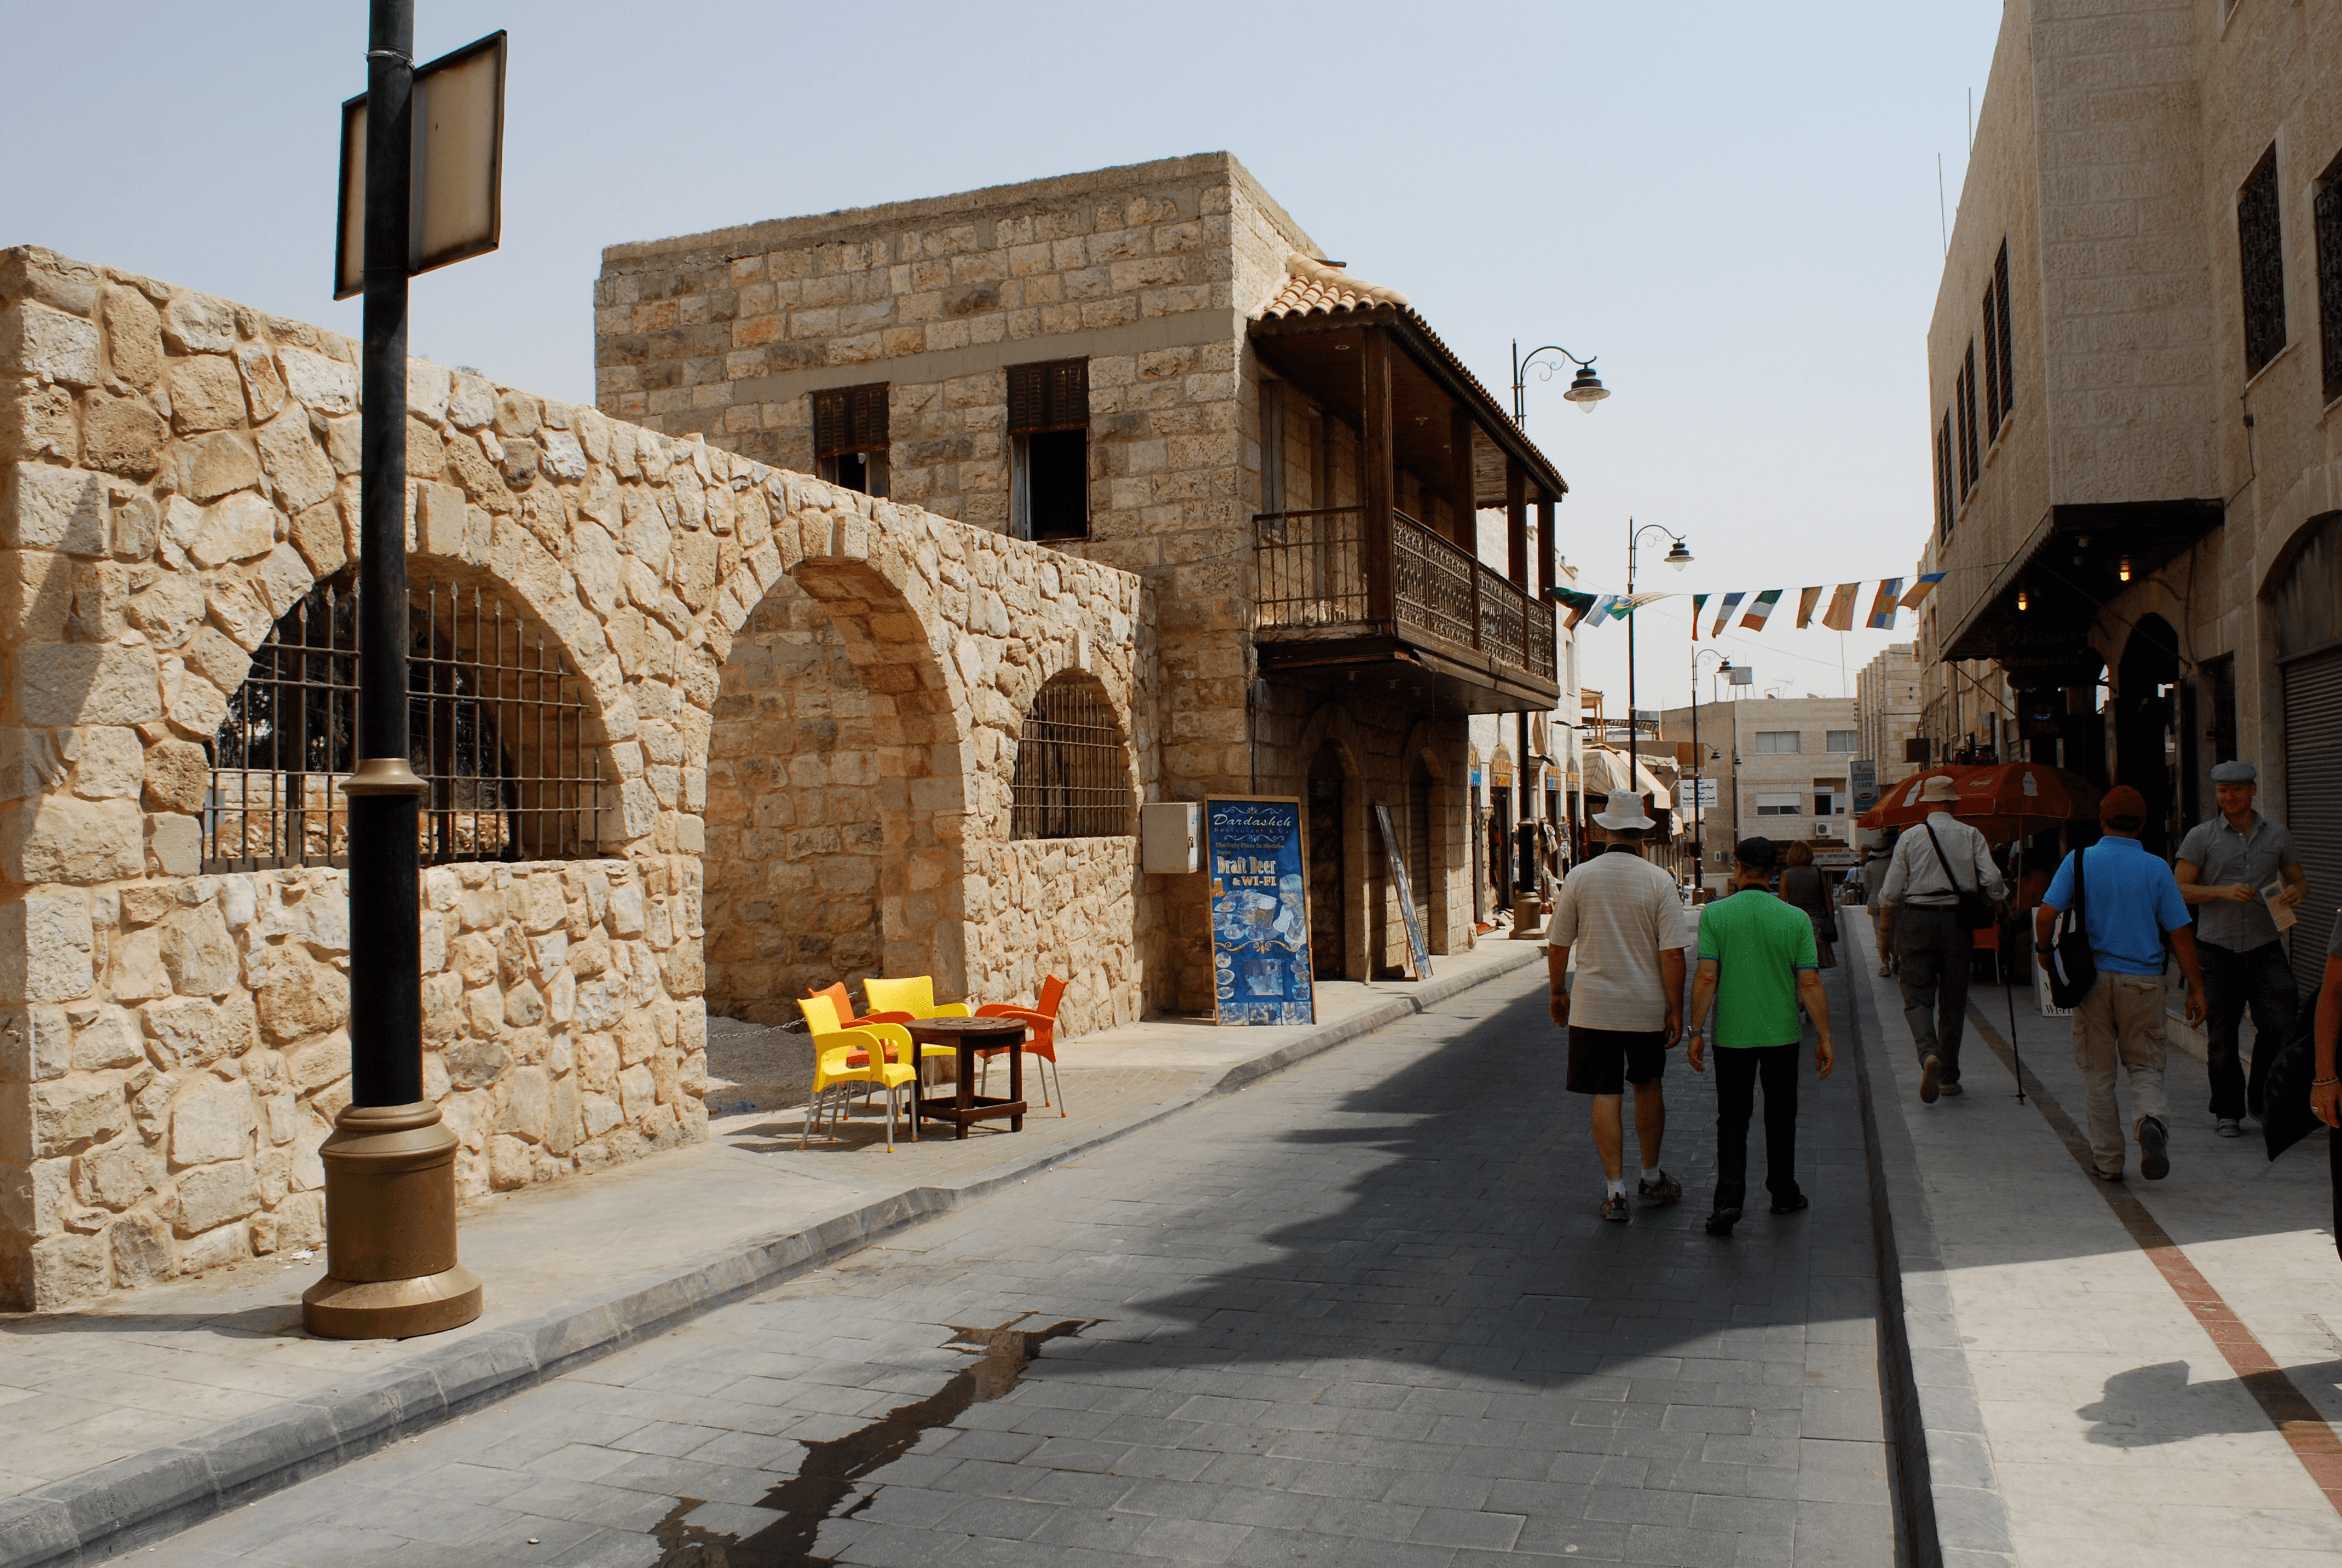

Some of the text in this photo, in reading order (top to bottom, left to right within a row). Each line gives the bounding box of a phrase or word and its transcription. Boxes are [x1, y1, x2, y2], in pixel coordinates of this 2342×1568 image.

[1213, 813, 1291, 826] Dardasheh
[1217, 856, 1276, 874] Draft Beer
[1241, 876, 1277, 886] WI-FI
